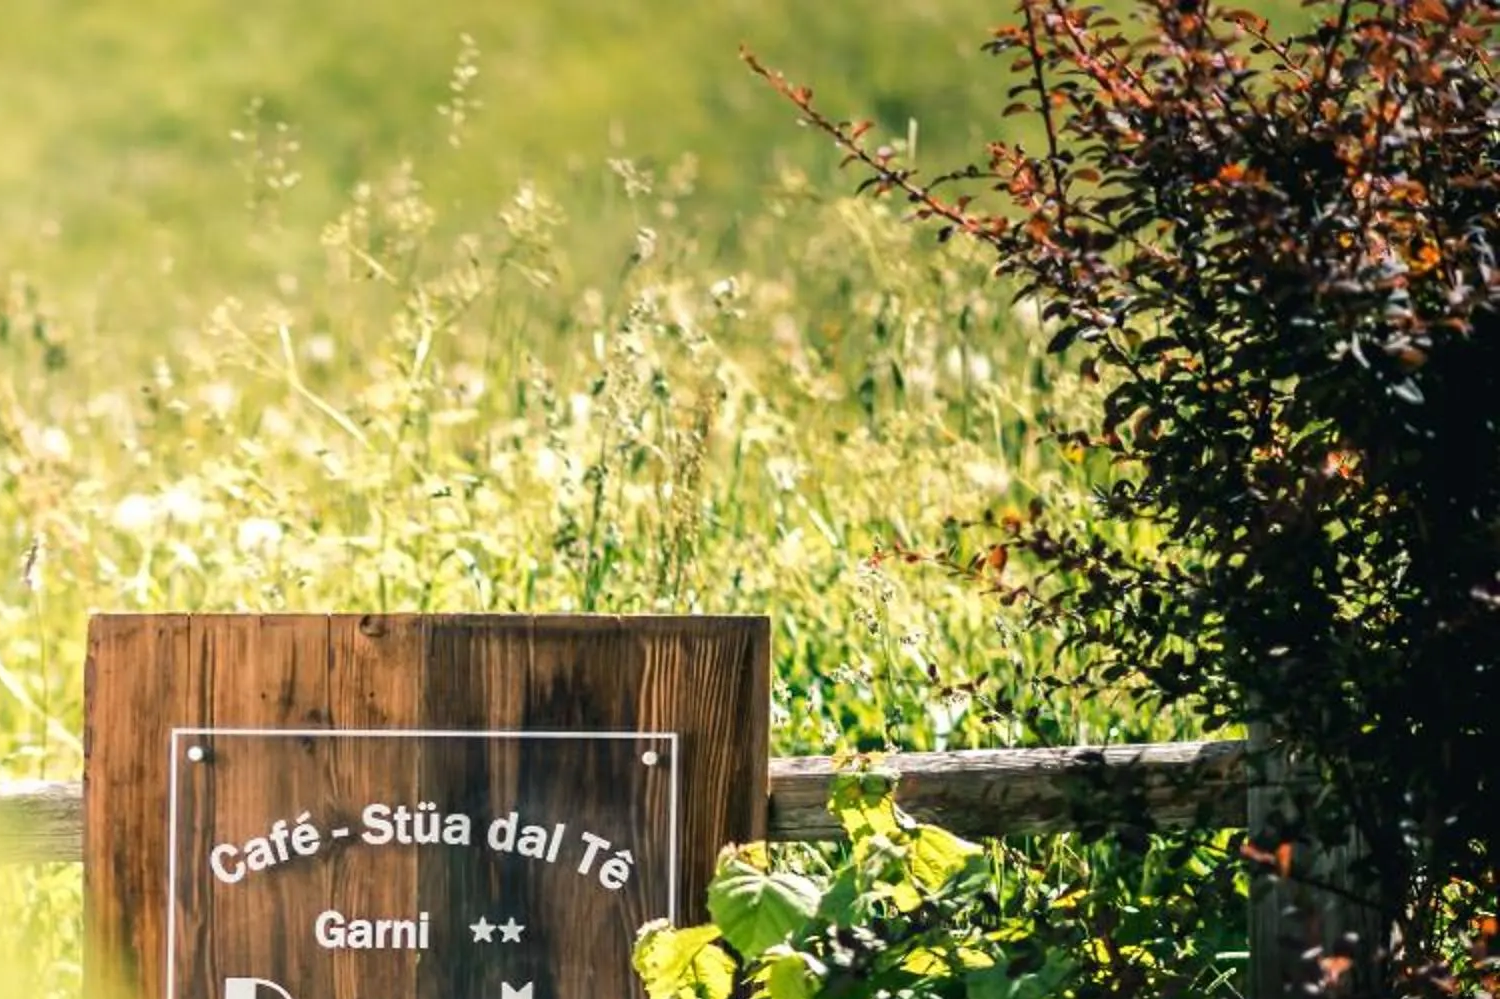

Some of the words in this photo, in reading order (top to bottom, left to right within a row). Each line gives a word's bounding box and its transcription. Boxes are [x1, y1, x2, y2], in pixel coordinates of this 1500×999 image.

[209, 810, 321, 885] Café
[361, 801, 471, 846] Stüa
[487, 811, 566, 863] dal
[577, 831, 634, 890] Tê
[314, 908, 429, 950] Garni
